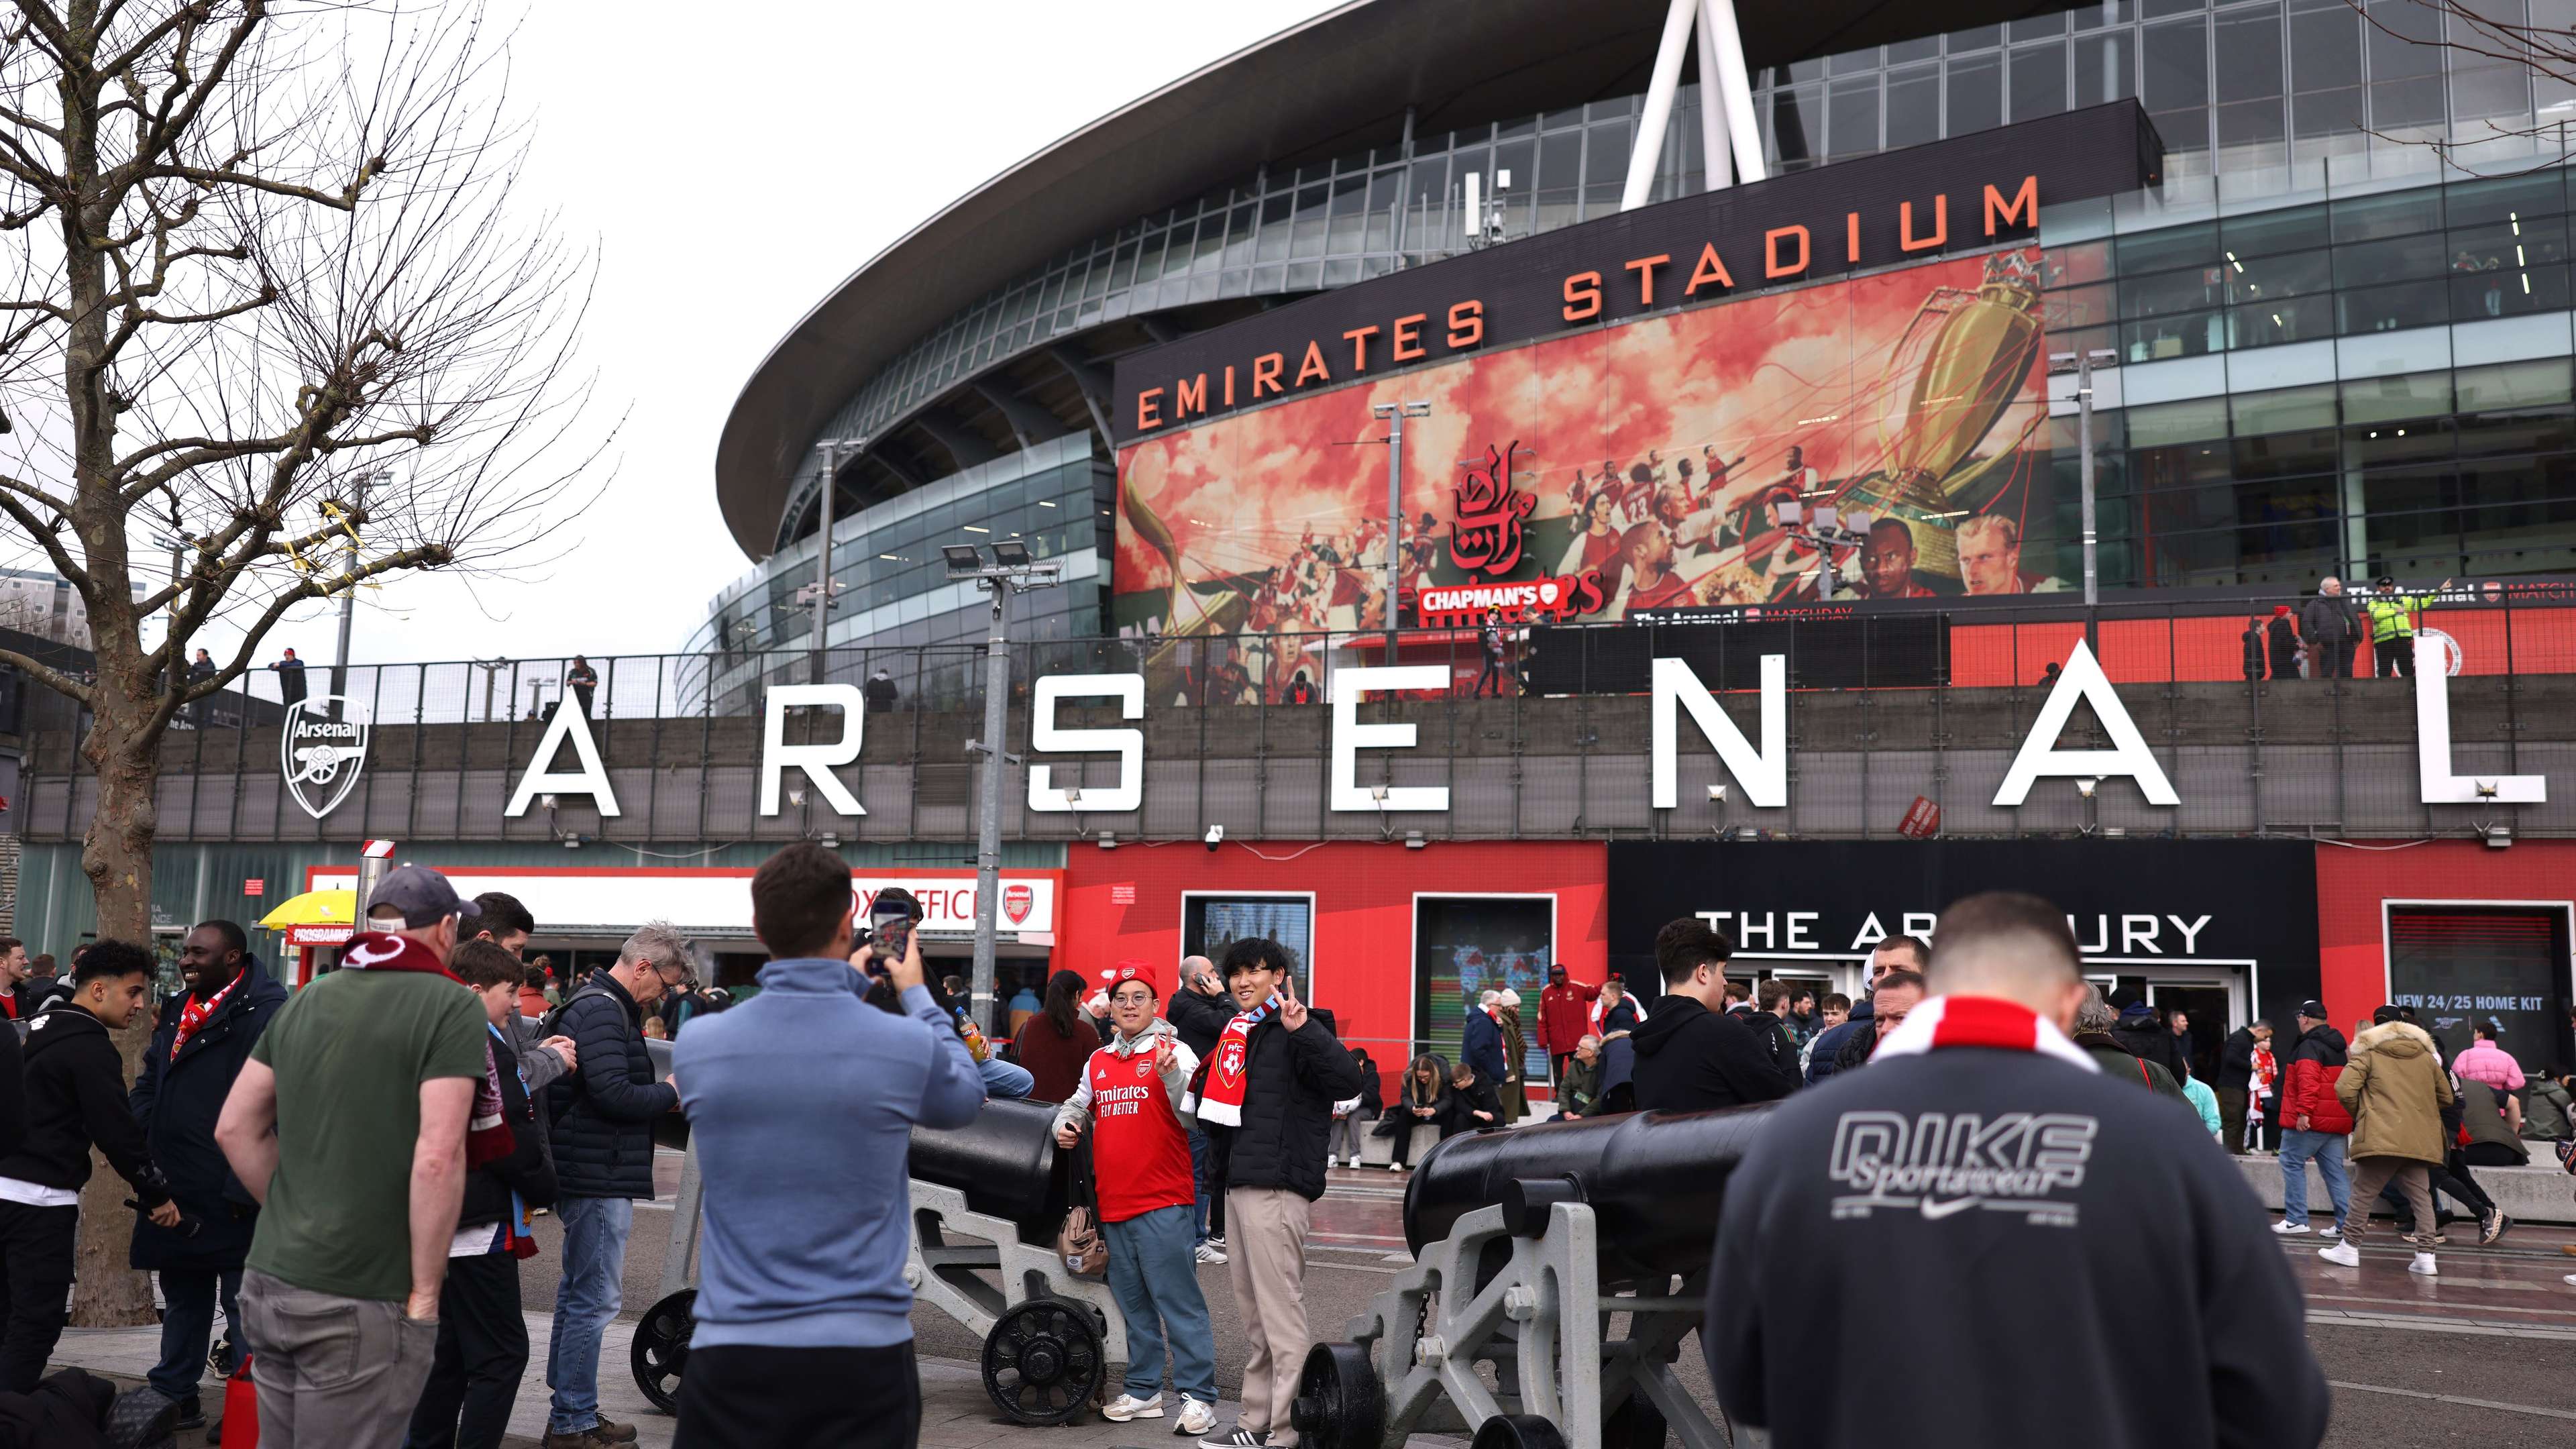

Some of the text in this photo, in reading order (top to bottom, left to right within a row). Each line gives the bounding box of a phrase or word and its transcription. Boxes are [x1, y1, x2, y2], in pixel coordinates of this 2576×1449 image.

[1138, 175, 2039, 431] EMIRATES STADIUM
[1423, 585, 1538, 611] CHAPMAN'S
[294, 720, 356, 738] Arsenal
[504, 637, 2547, 817] ARSENAL
[1695, 911, 2212, 955] THE ARURY
[2394, 994, 2543, 1012] NEW 24/25 HOME KIT
[1228, 1042, 1244, 1053] AFC
[1095, 1084, 1149, 1105] Emirates
[1101, 1101, 1138, 1118] FLY BETTER
[1849, 1152, 2058, 1199] Sportswear
